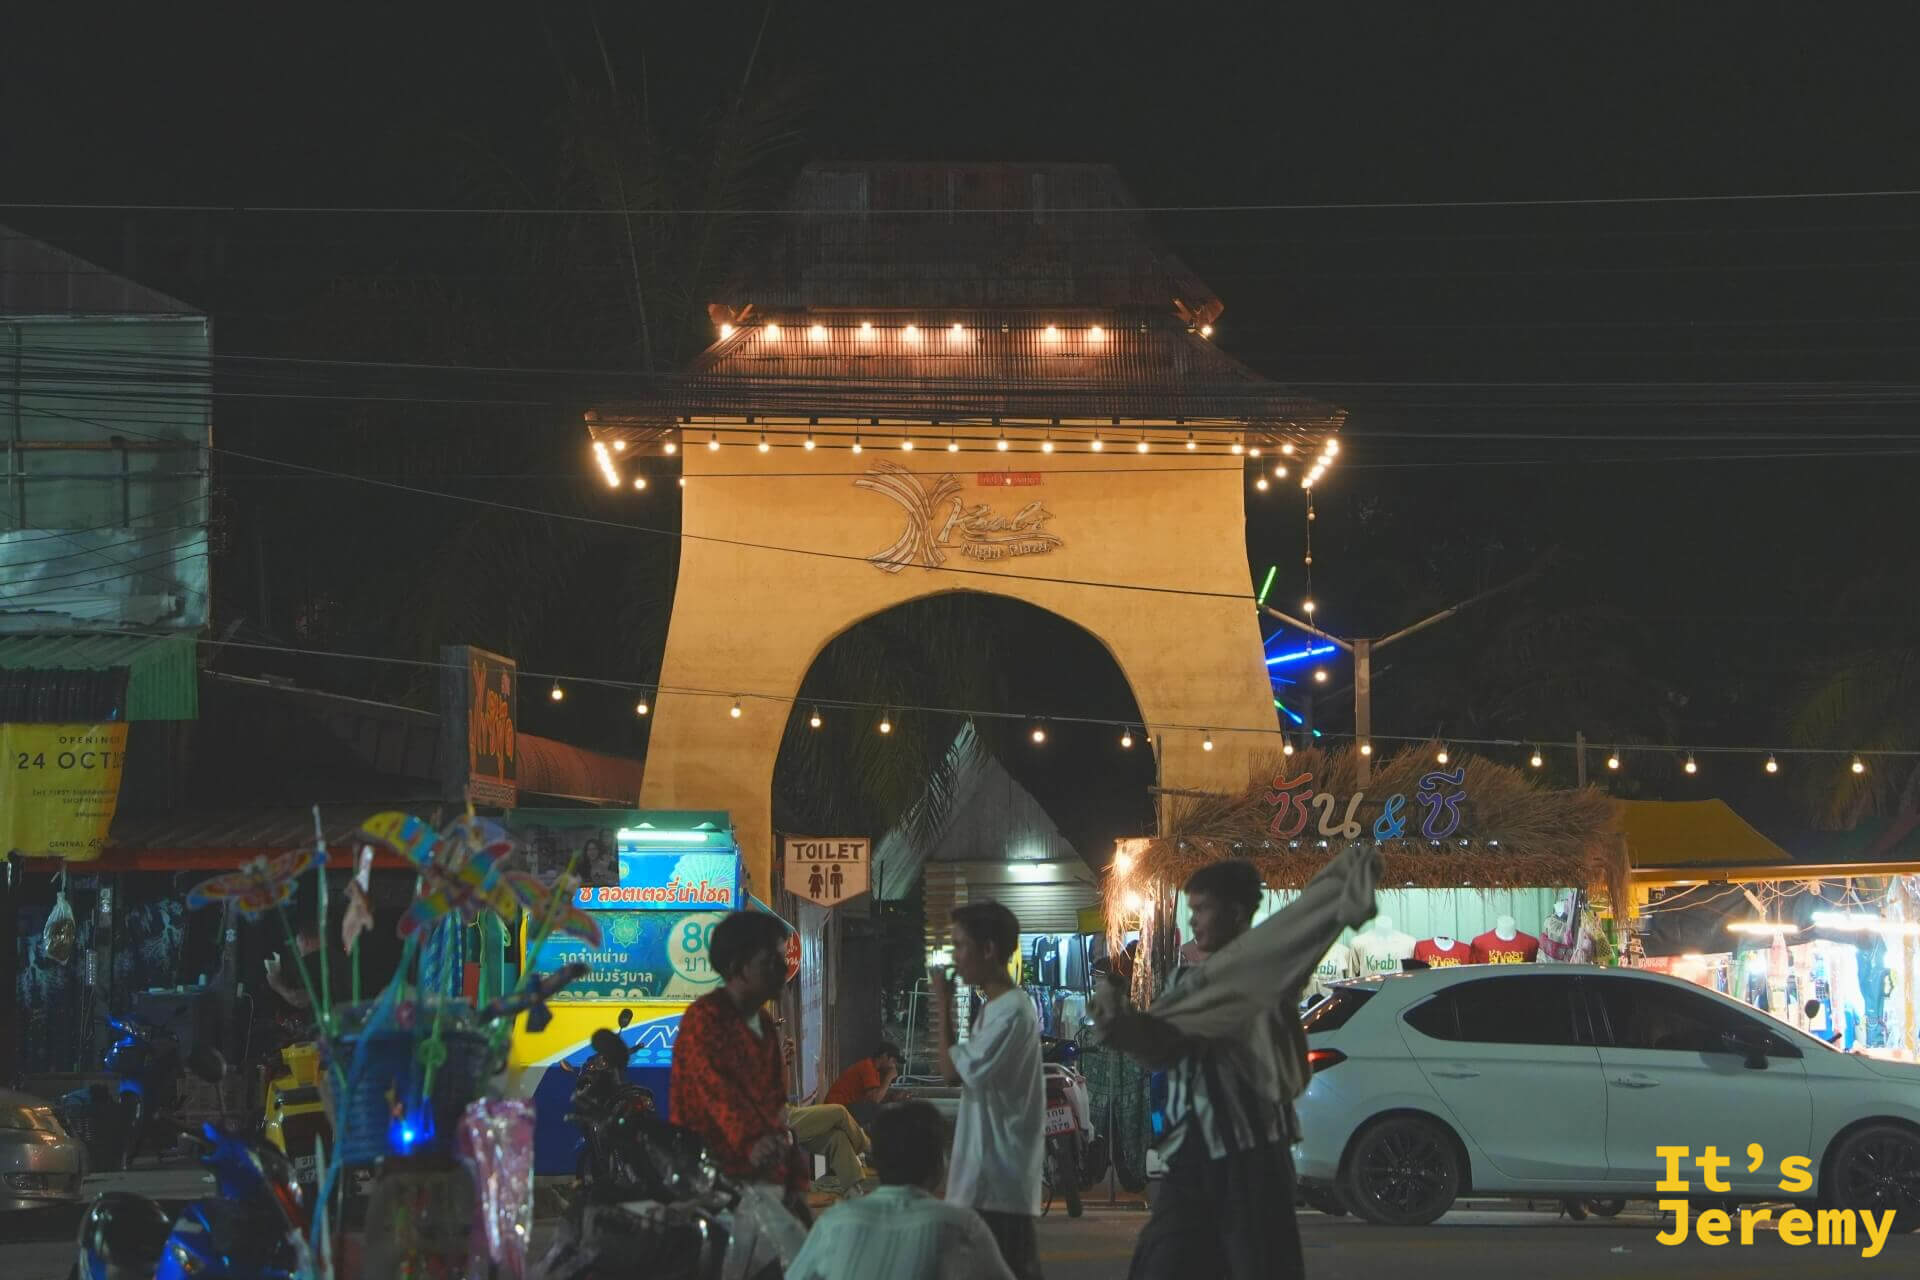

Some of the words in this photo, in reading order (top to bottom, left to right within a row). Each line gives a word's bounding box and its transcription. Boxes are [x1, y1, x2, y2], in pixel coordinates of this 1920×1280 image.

[18, 752, 46, 769] 24
[58, 752, 111, 769] OCT
[1373, 792, 1407, 840] &
[791, 842, 865, 860] TOILET
[684, 957, 713, 972] บา
[1366, 953, 1398, 971] Krabi
